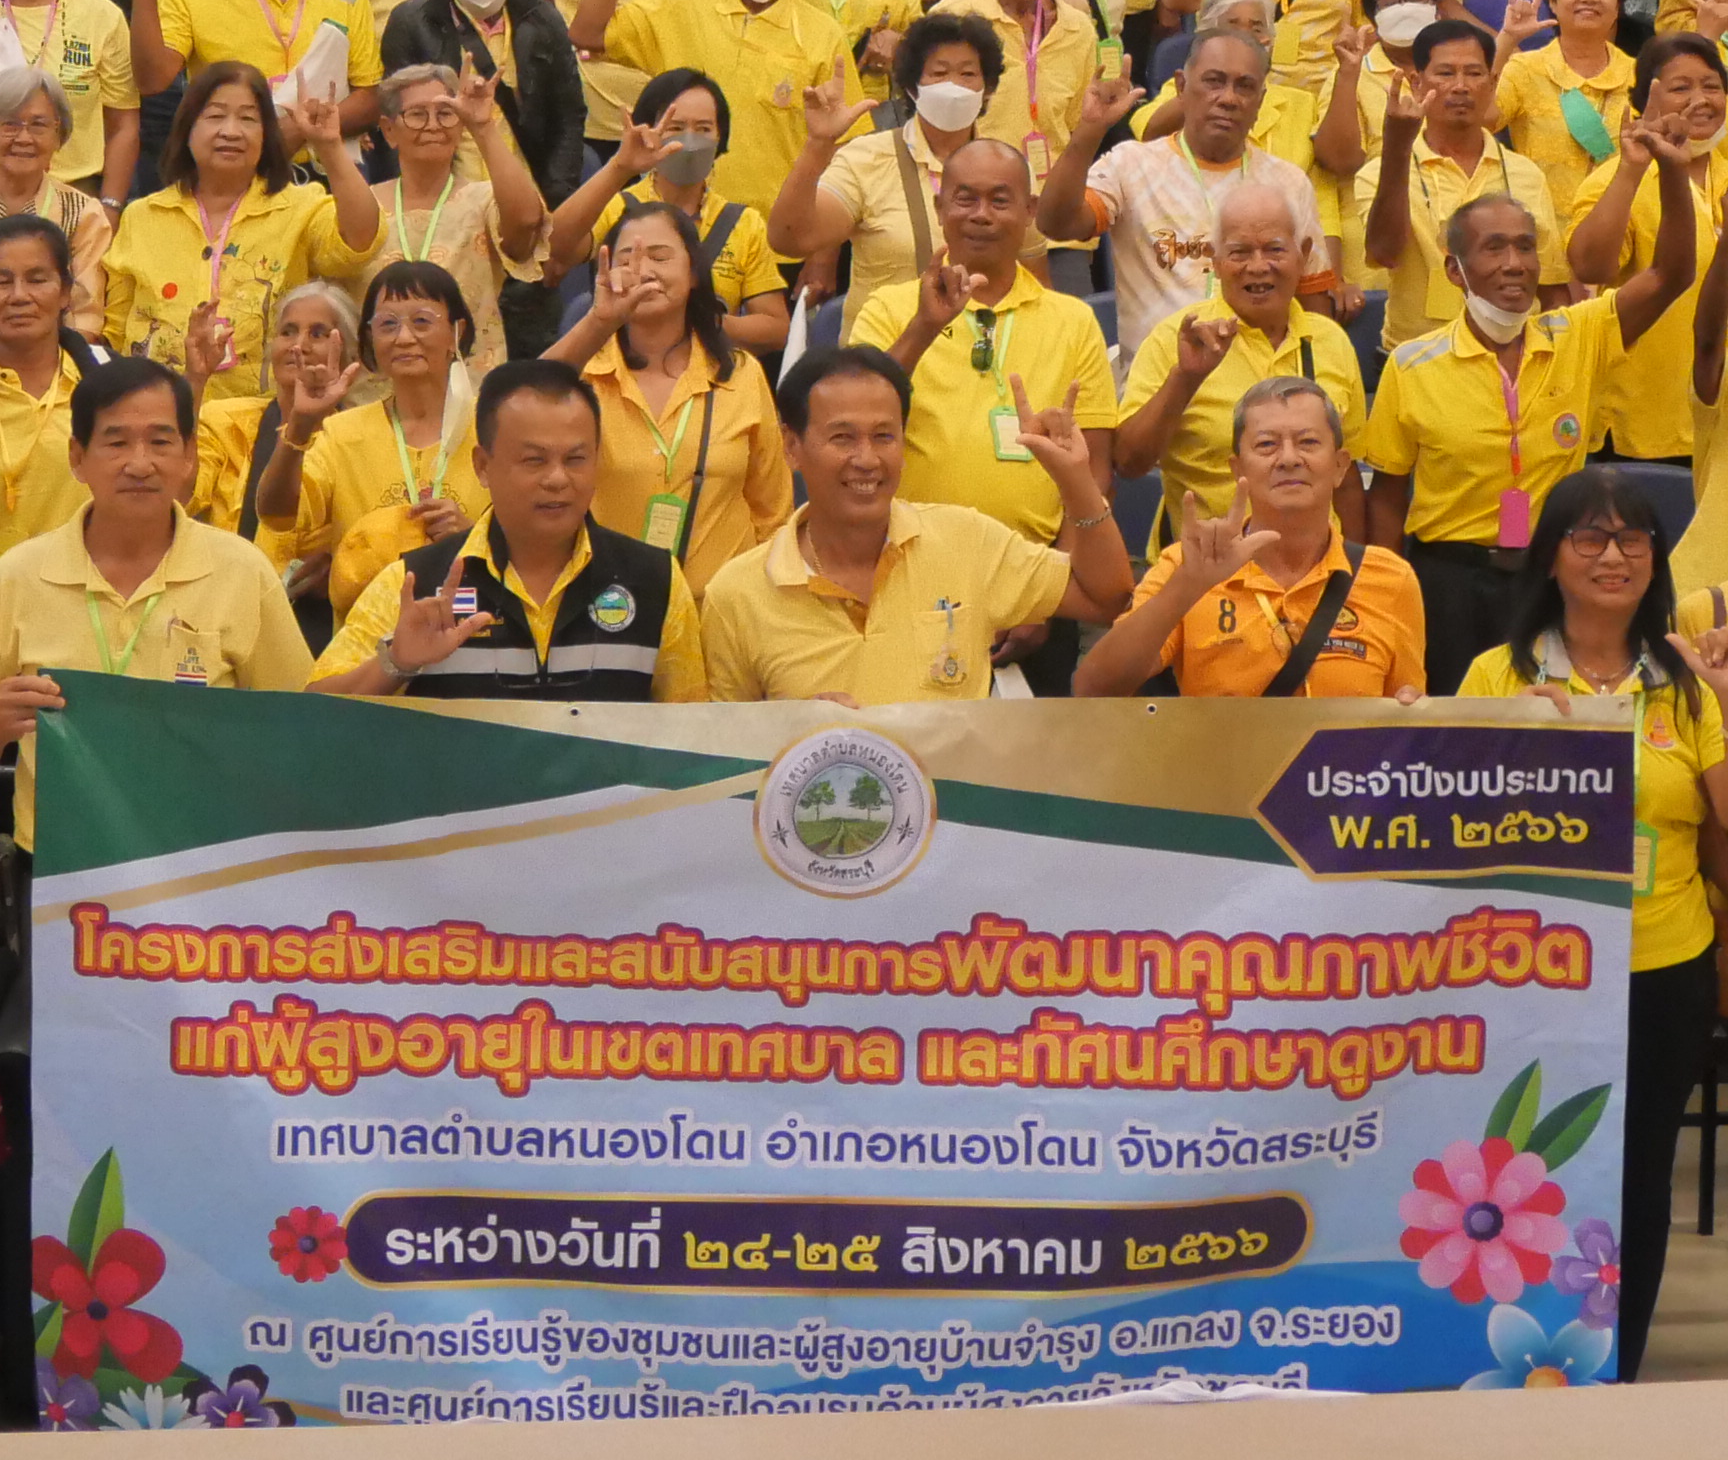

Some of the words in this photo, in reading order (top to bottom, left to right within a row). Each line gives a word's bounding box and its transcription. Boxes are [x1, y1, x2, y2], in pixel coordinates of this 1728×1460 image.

[1218, 598, 1237, 634] 8
[1306, 760, 1614, 799] ประจำปีงบประมาณ
[1328, 813, 1431, 850] พ.ศ.
[1449, 809, 1590, 849] ๒๕๖๖
[73, 904, 1590, 1017] โครงการส่งเสริมและสนับสนุนการพัฒนาคุณภาพชีวิต
[174, 996, 903, 1096] แก่ผู้สูงอายุในเขตเทศบาล
[920, 1010, 1484, 1098] และทัศนศึกษาดูงาน
[276, 1114, 746, 1161] เทศบาลตำบลหนองโดน
[766, 1117, 1097, 1168] อำเภอหนองโดน
[1118, 1111, 1379, 1170] จังหวัดสระบุรี
[384, 1206, 662, 1270] ระหว่างวันที่
[900, 1226, 1103, 1275] สิงหาคม
[1123, 1228, 1270, 1271] ๒๕๖๖
[248, 1320, 287, 1348] ณ
[1114, 1312, 1236, 1349] อ.แกลง
[1255, 1307, 1394, 1342] จ.ระยอง
